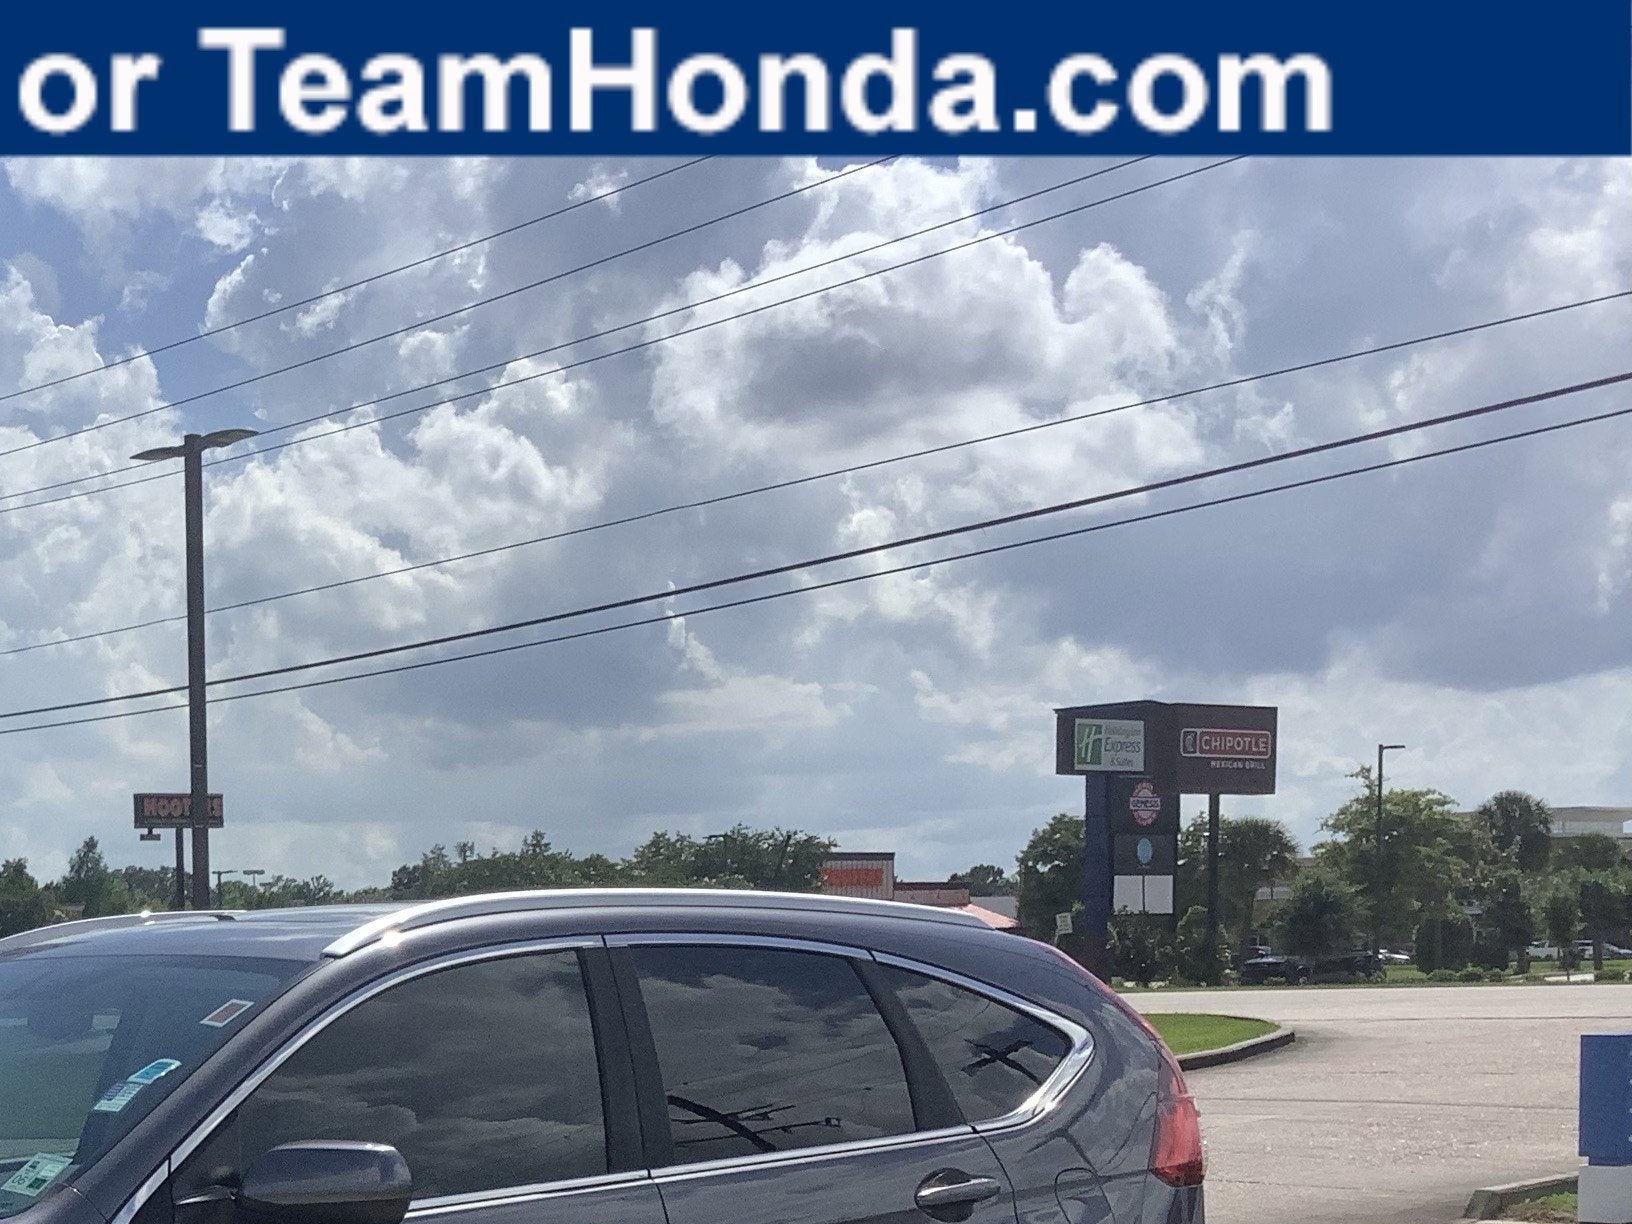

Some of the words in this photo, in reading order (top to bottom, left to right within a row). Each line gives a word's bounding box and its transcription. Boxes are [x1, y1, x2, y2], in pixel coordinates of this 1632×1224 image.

[1104, 737, 1141, 755] Express
[1201, 735, 1267, 752] CHIPOTLE
[143, 797, 222, 817] HOOTS
